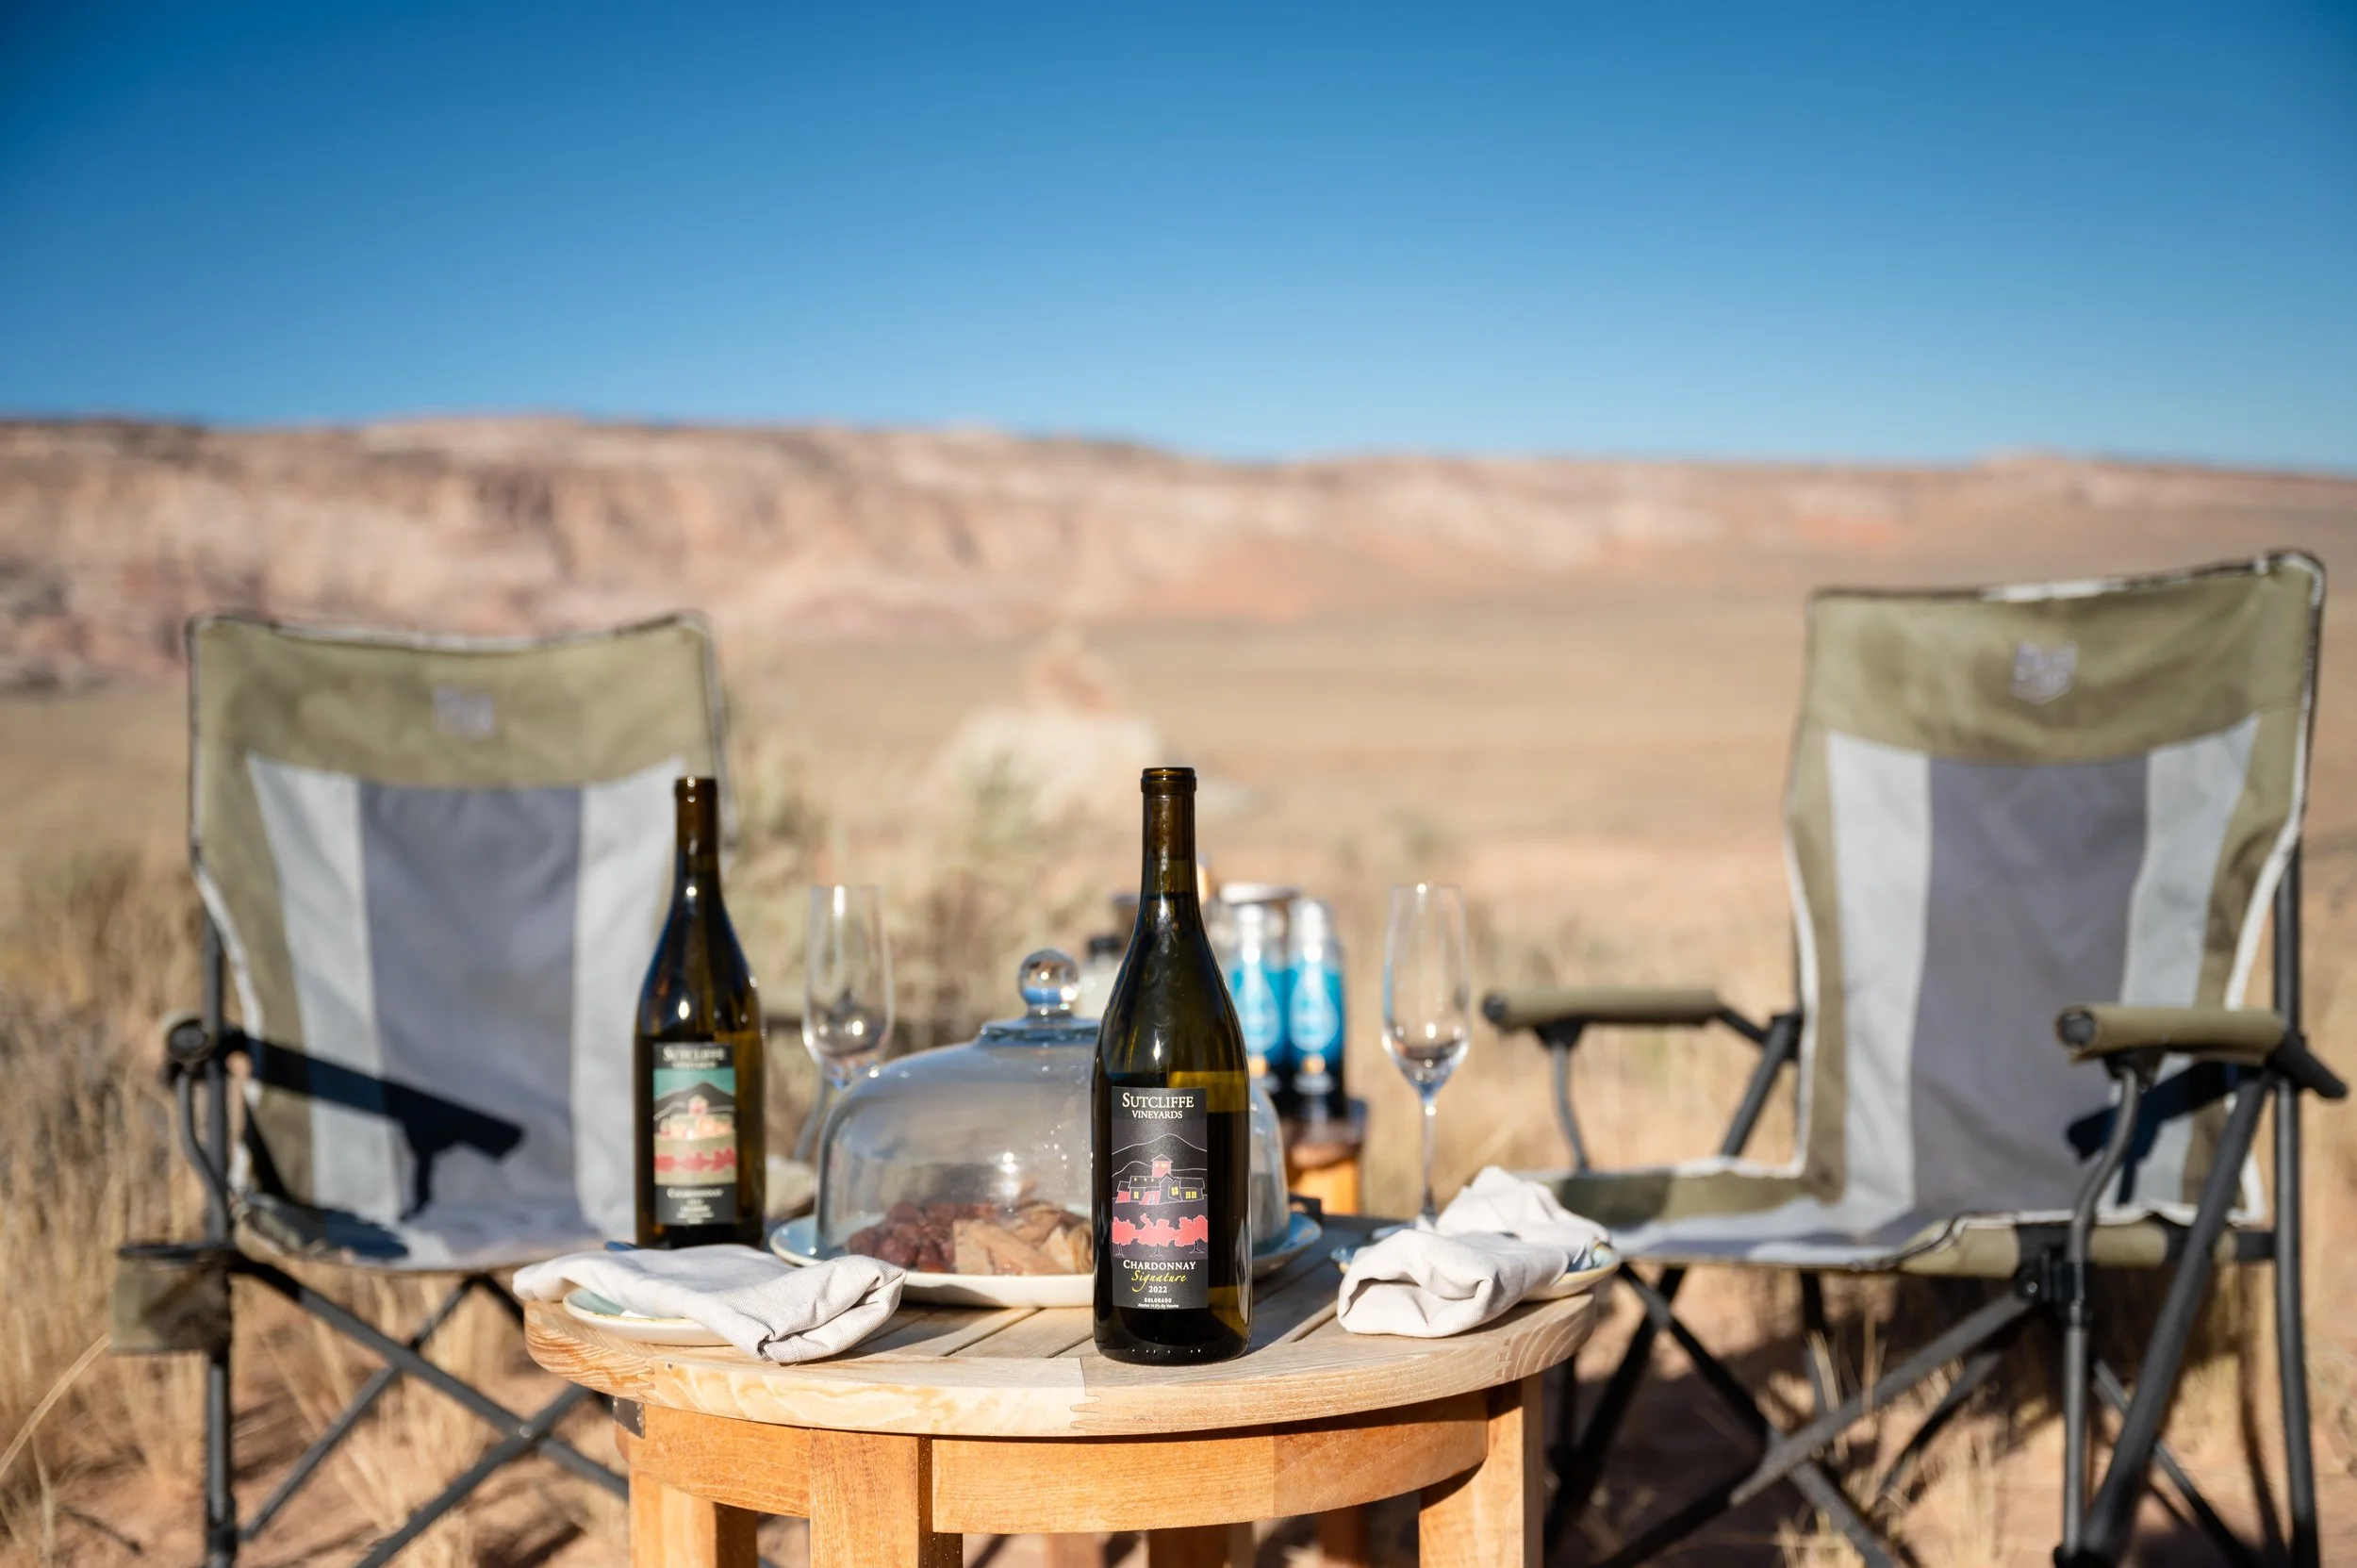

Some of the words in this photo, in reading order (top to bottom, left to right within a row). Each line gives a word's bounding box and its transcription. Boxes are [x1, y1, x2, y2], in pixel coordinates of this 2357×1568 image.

[1122, 1092, 1195, 1108] SUTCLIFFE
[1131, 1110, 1183, 1119] VINEYARDS
[1123, 1259, 1196, 1270] CHARDONNAY
[1131, 1269, 1188, 1293] Signature
[1148, 1285, 1168, 1294] 2022
